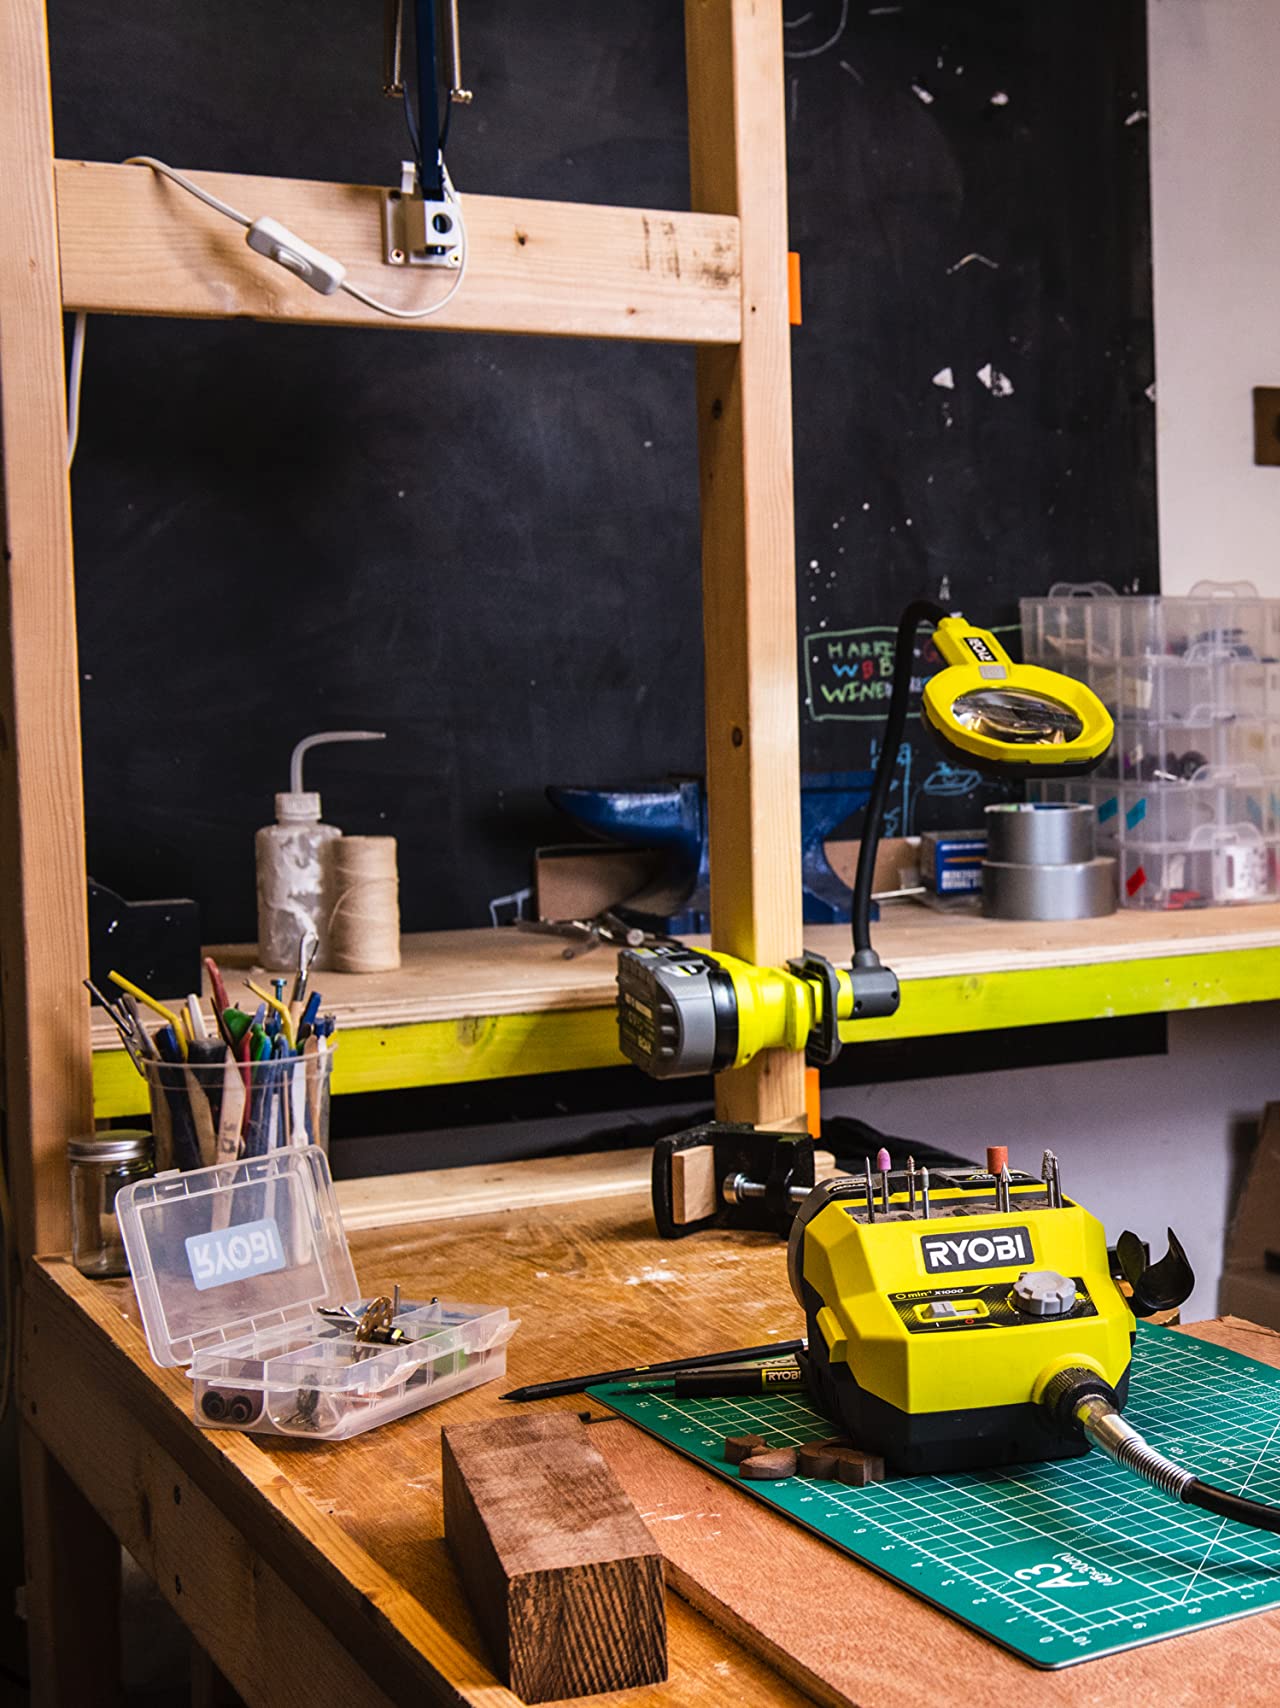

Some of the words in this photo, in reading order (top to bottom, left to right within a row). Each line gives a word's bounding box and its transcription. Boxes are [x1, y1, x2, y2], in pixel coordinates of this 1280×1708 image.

[926, 1234, 1026, 1268] RYOBI
[1014, 1563, 1090, 1589] A3
[972, 1597, 988, 1605] 2
[1039, 1636, 1054, 1644] 0
[1072, 1636, 1092, 1646] 10
[1132, 1622, 1147, 1630] 9
